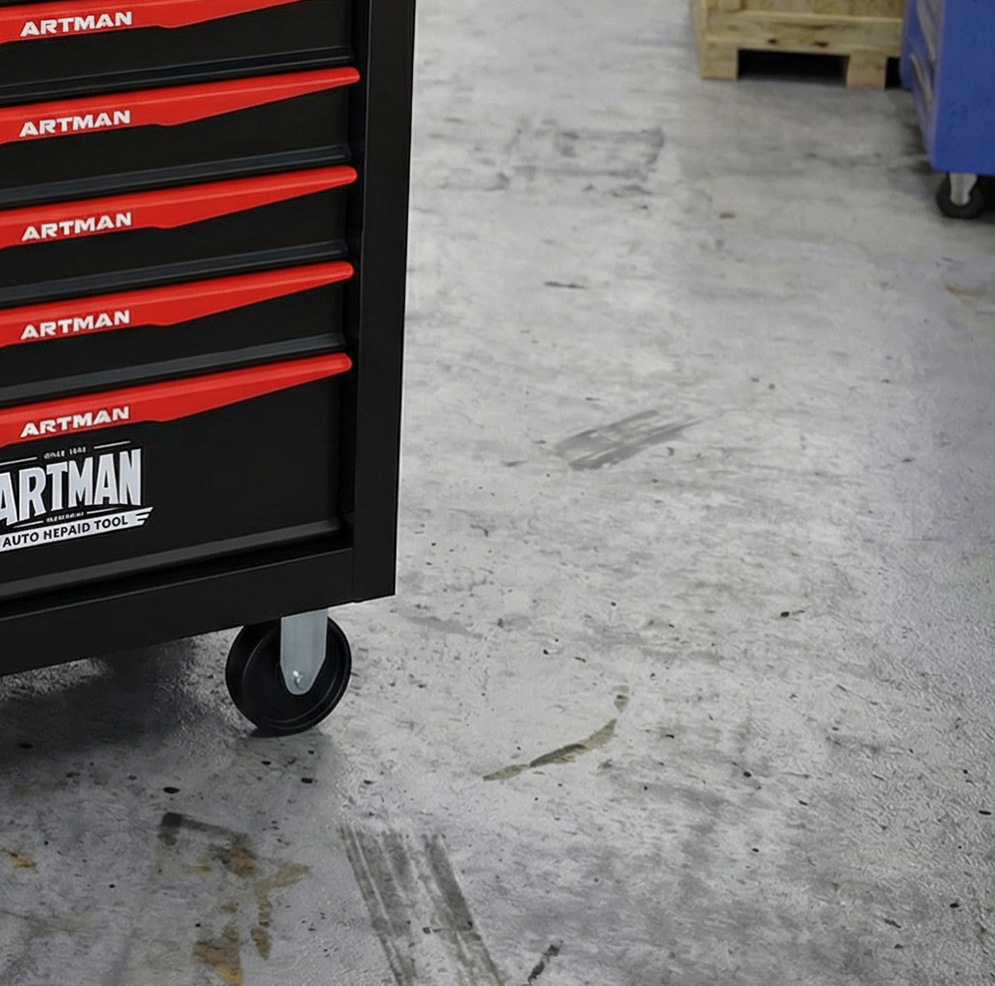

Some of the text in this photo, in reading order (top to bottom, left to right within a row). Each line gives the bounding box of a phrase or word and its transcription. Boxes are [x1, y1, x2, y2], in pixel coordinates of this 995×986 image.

[20, 11, 132, 37] ARTMAN
[19, 110, 130, 137] ARTMAN
[22, 212, 131, 241] ARTMAN
[20, 310, 130, 340] ARTMAN
[20, 406, 129, 438] ARTMAN
[2, 532, 39, 548] AUTO
[94, 515, 128, 530] TOOL
